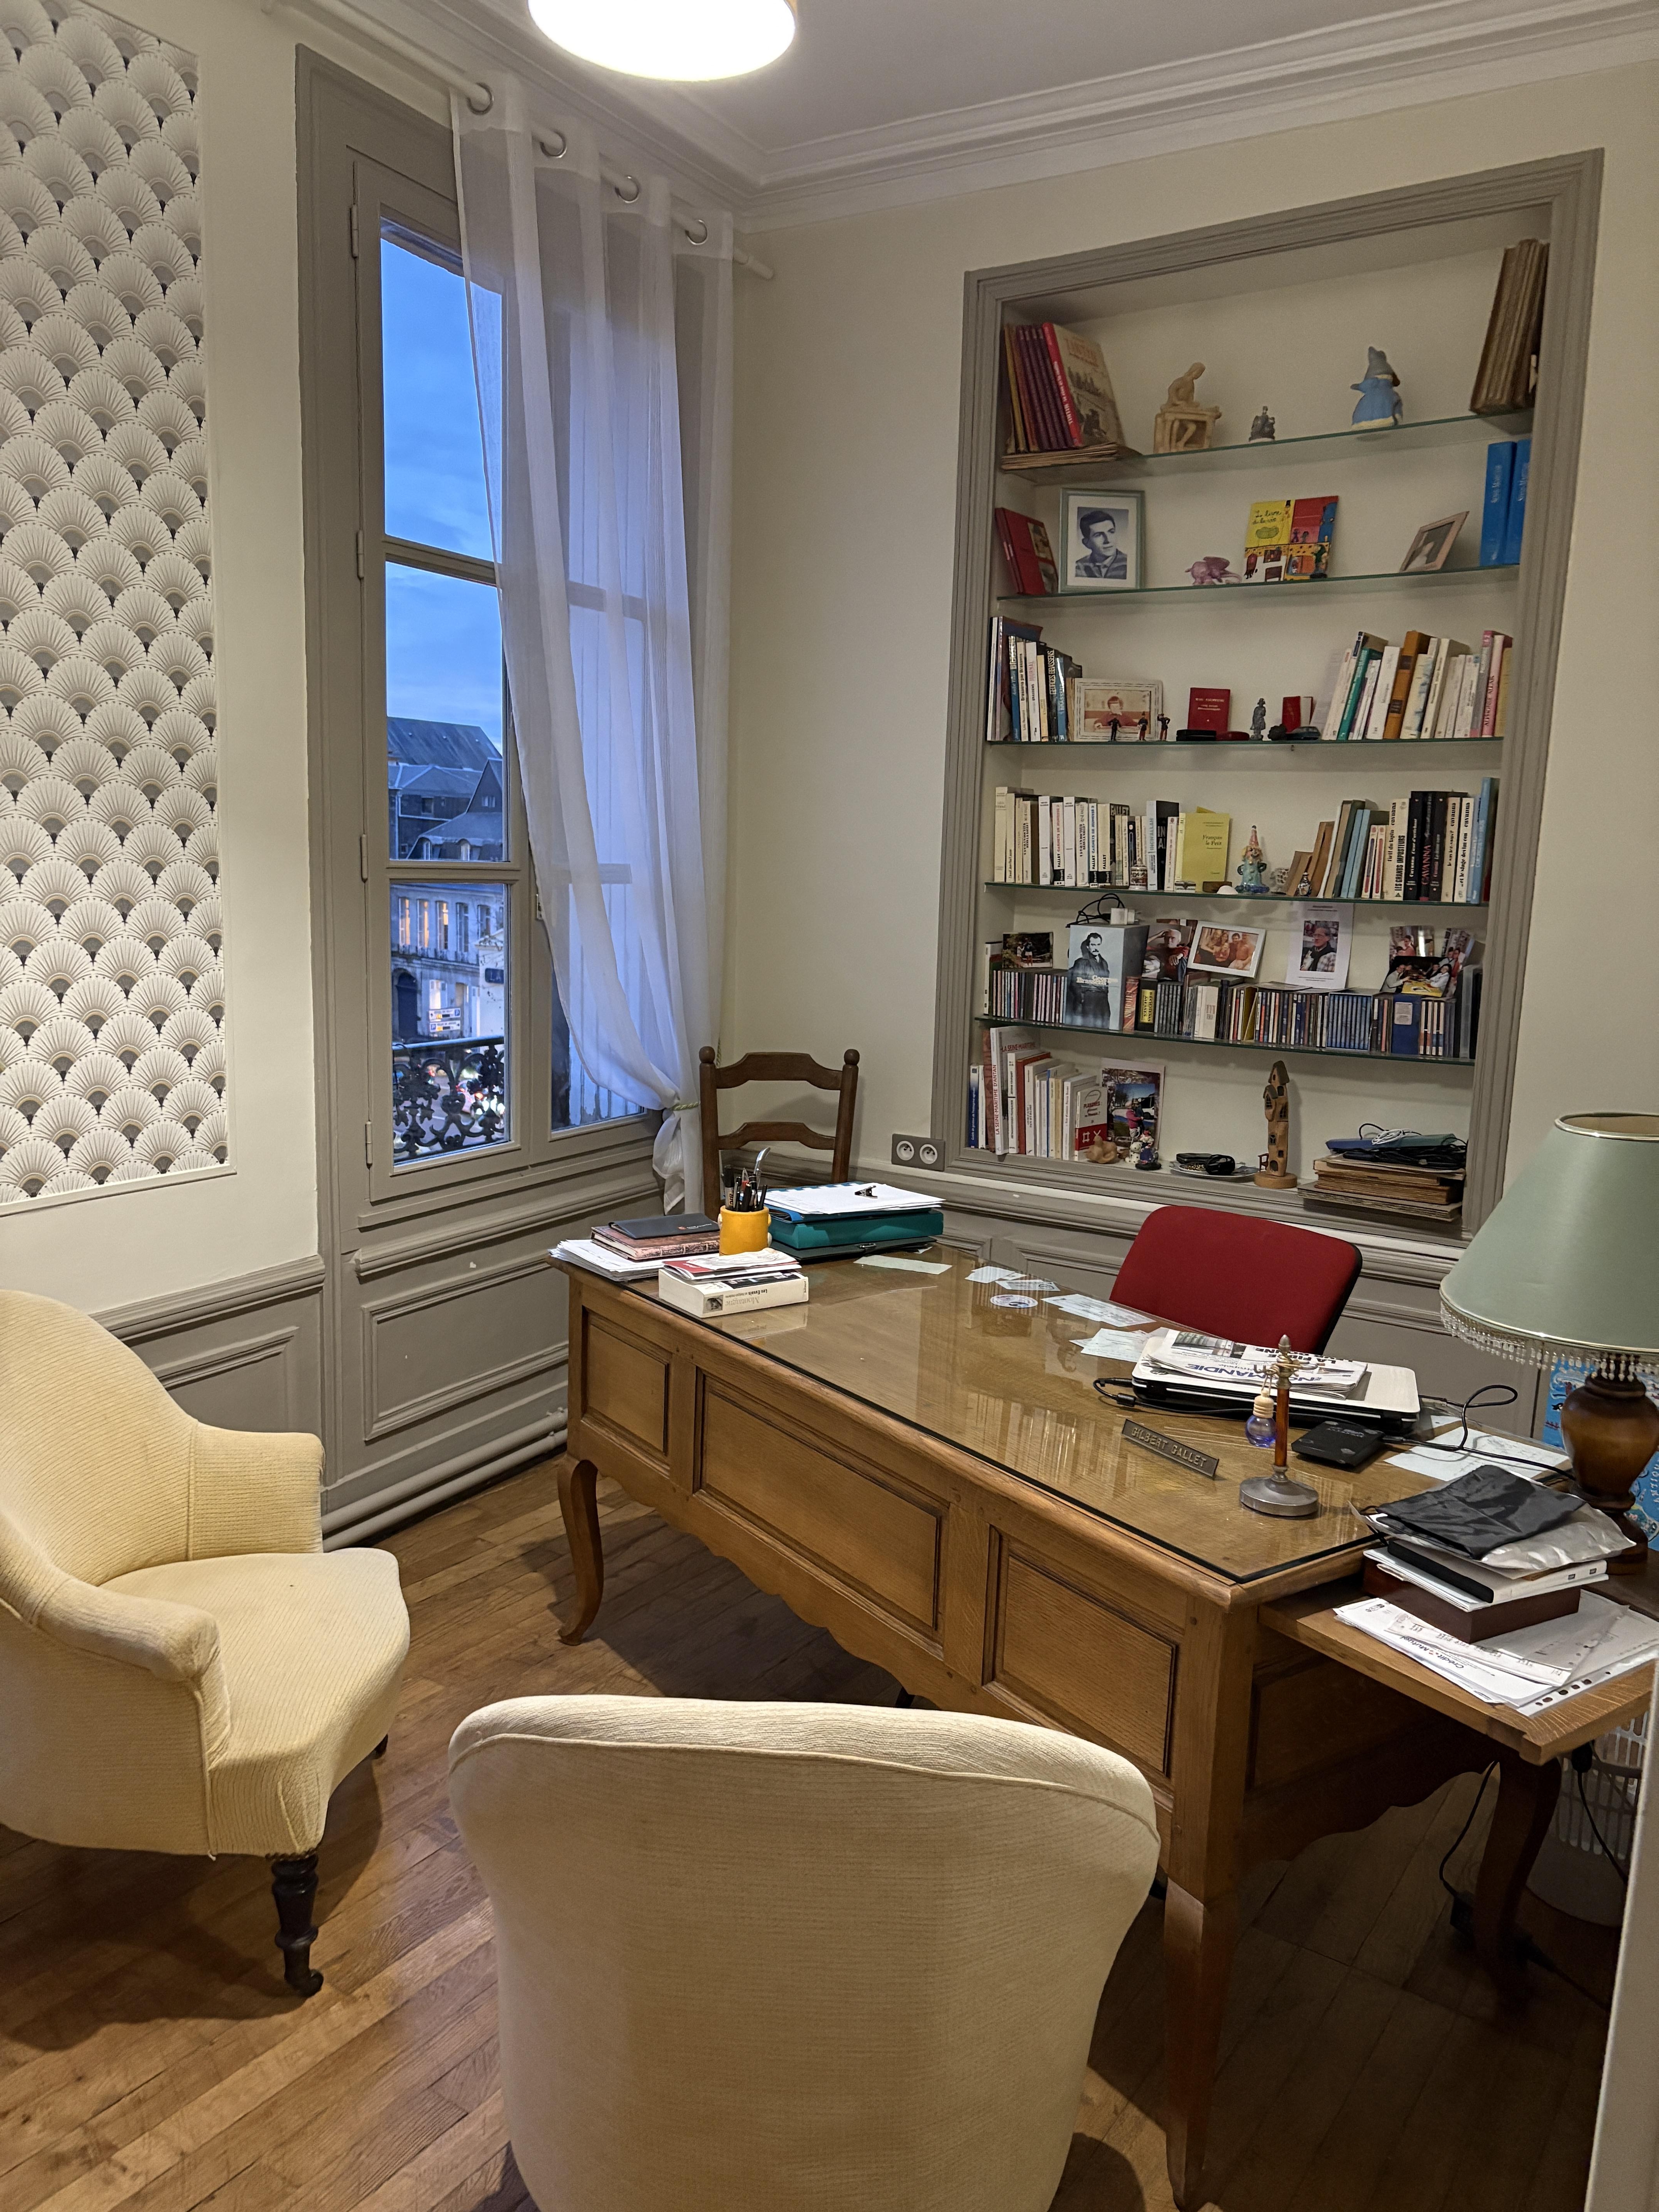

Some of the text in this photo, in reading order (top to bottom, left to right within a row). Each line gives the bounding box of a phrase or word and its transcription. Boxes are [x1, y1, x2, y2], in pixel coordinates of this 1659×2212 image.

[1421, 845, 1431, 885] CAVANNA
[725, 1296, 759, 1306] Montaigne
[1132, 1427, 1207, 1467] GILBERT GALLET
[1399, 1636, 1464, 1669] Crédit Mutuel
